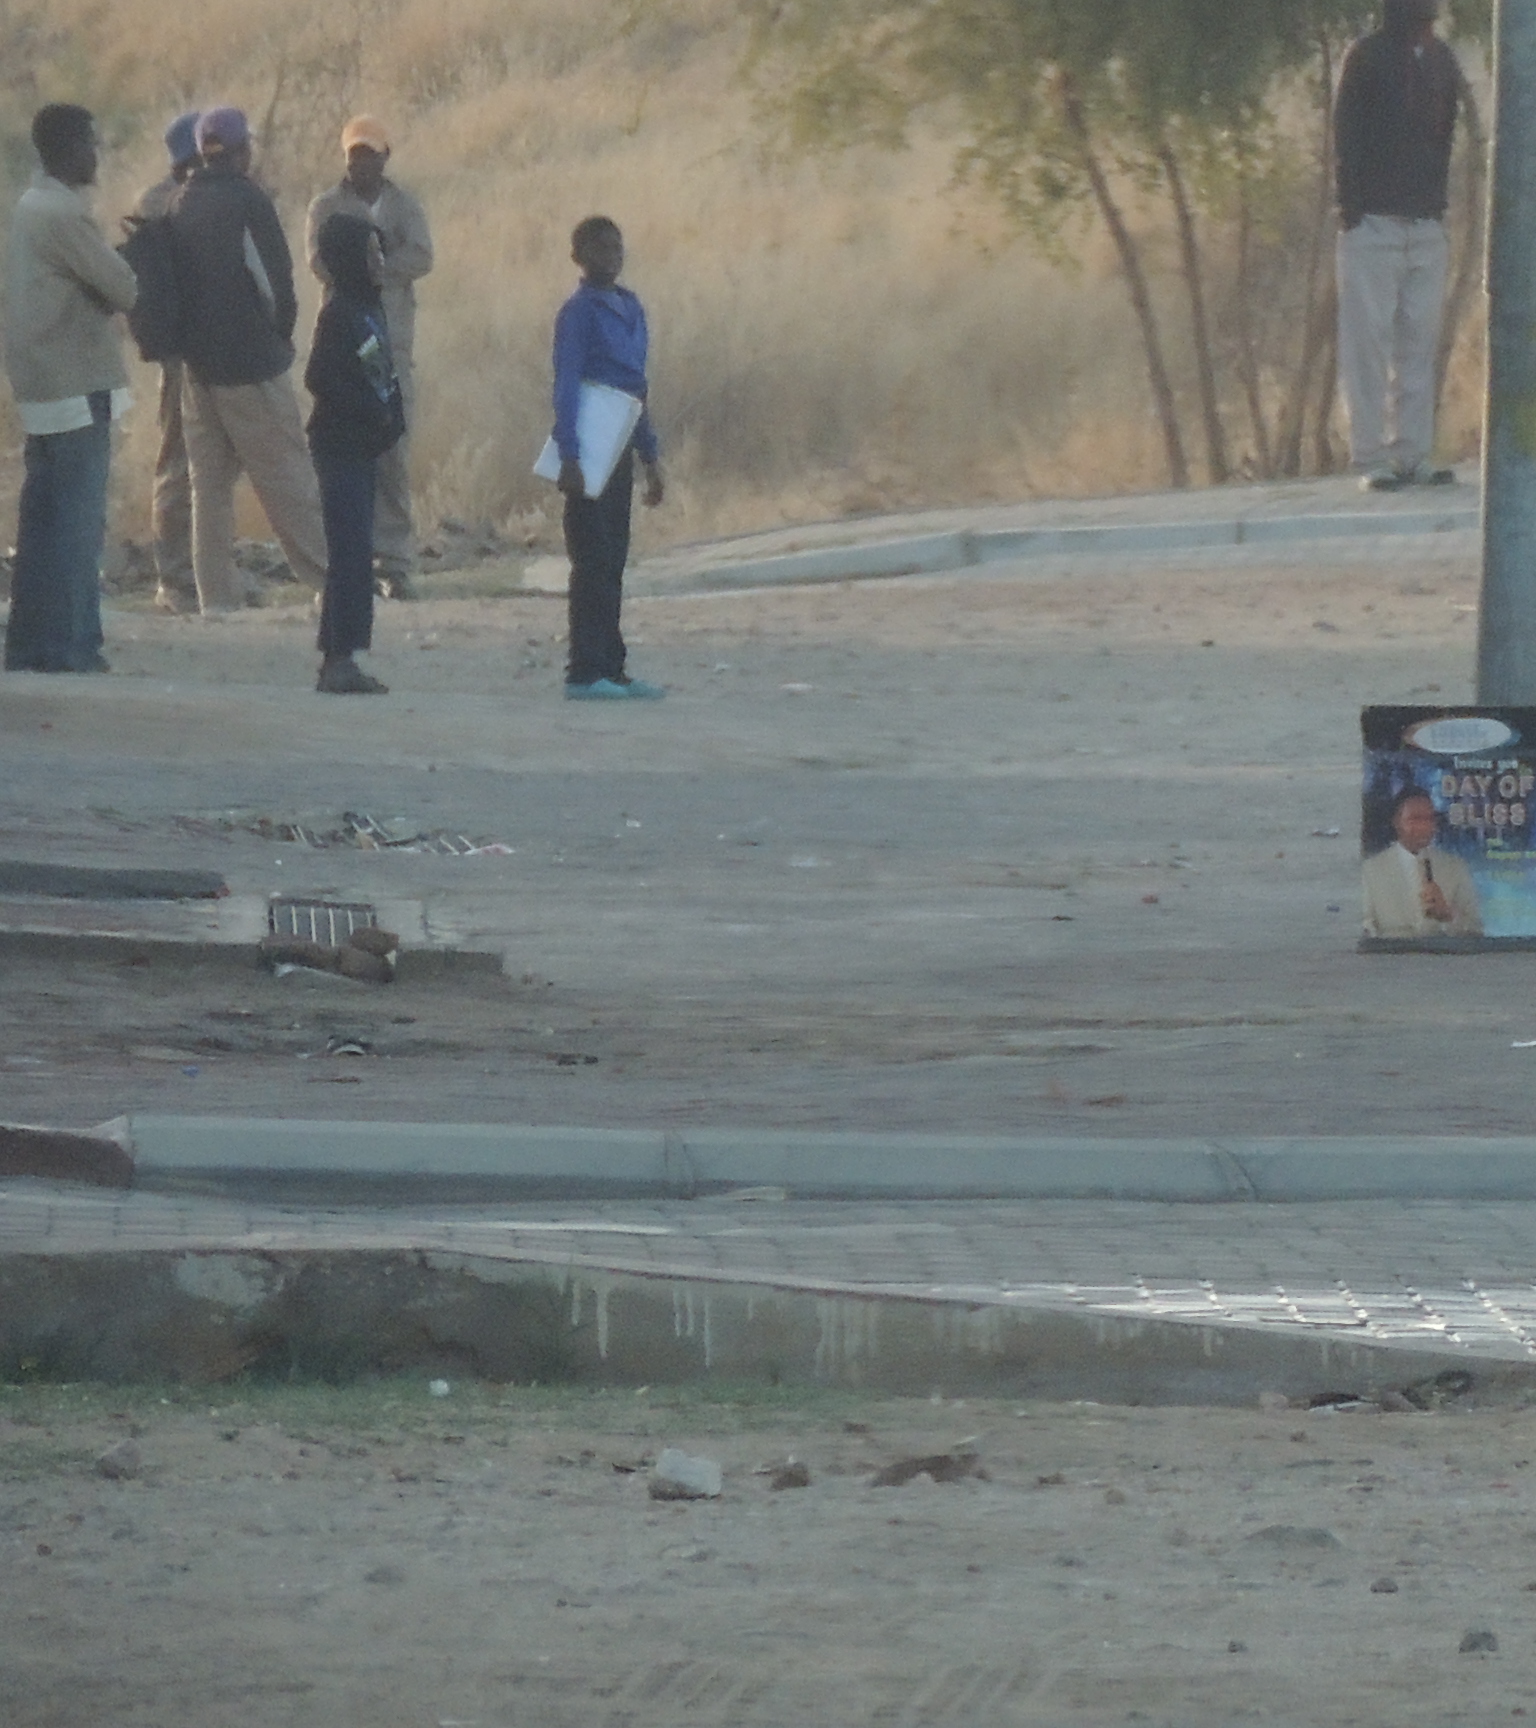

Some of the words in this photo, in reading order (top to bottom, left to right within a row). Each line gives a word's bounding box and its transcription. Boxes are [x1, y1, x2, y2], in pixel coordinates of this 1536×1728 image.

[1441, 774, 1493, 798] DAY
[1498, 774, 1535, 799] OF
[1448, 802, 1528, 826] BLISS
